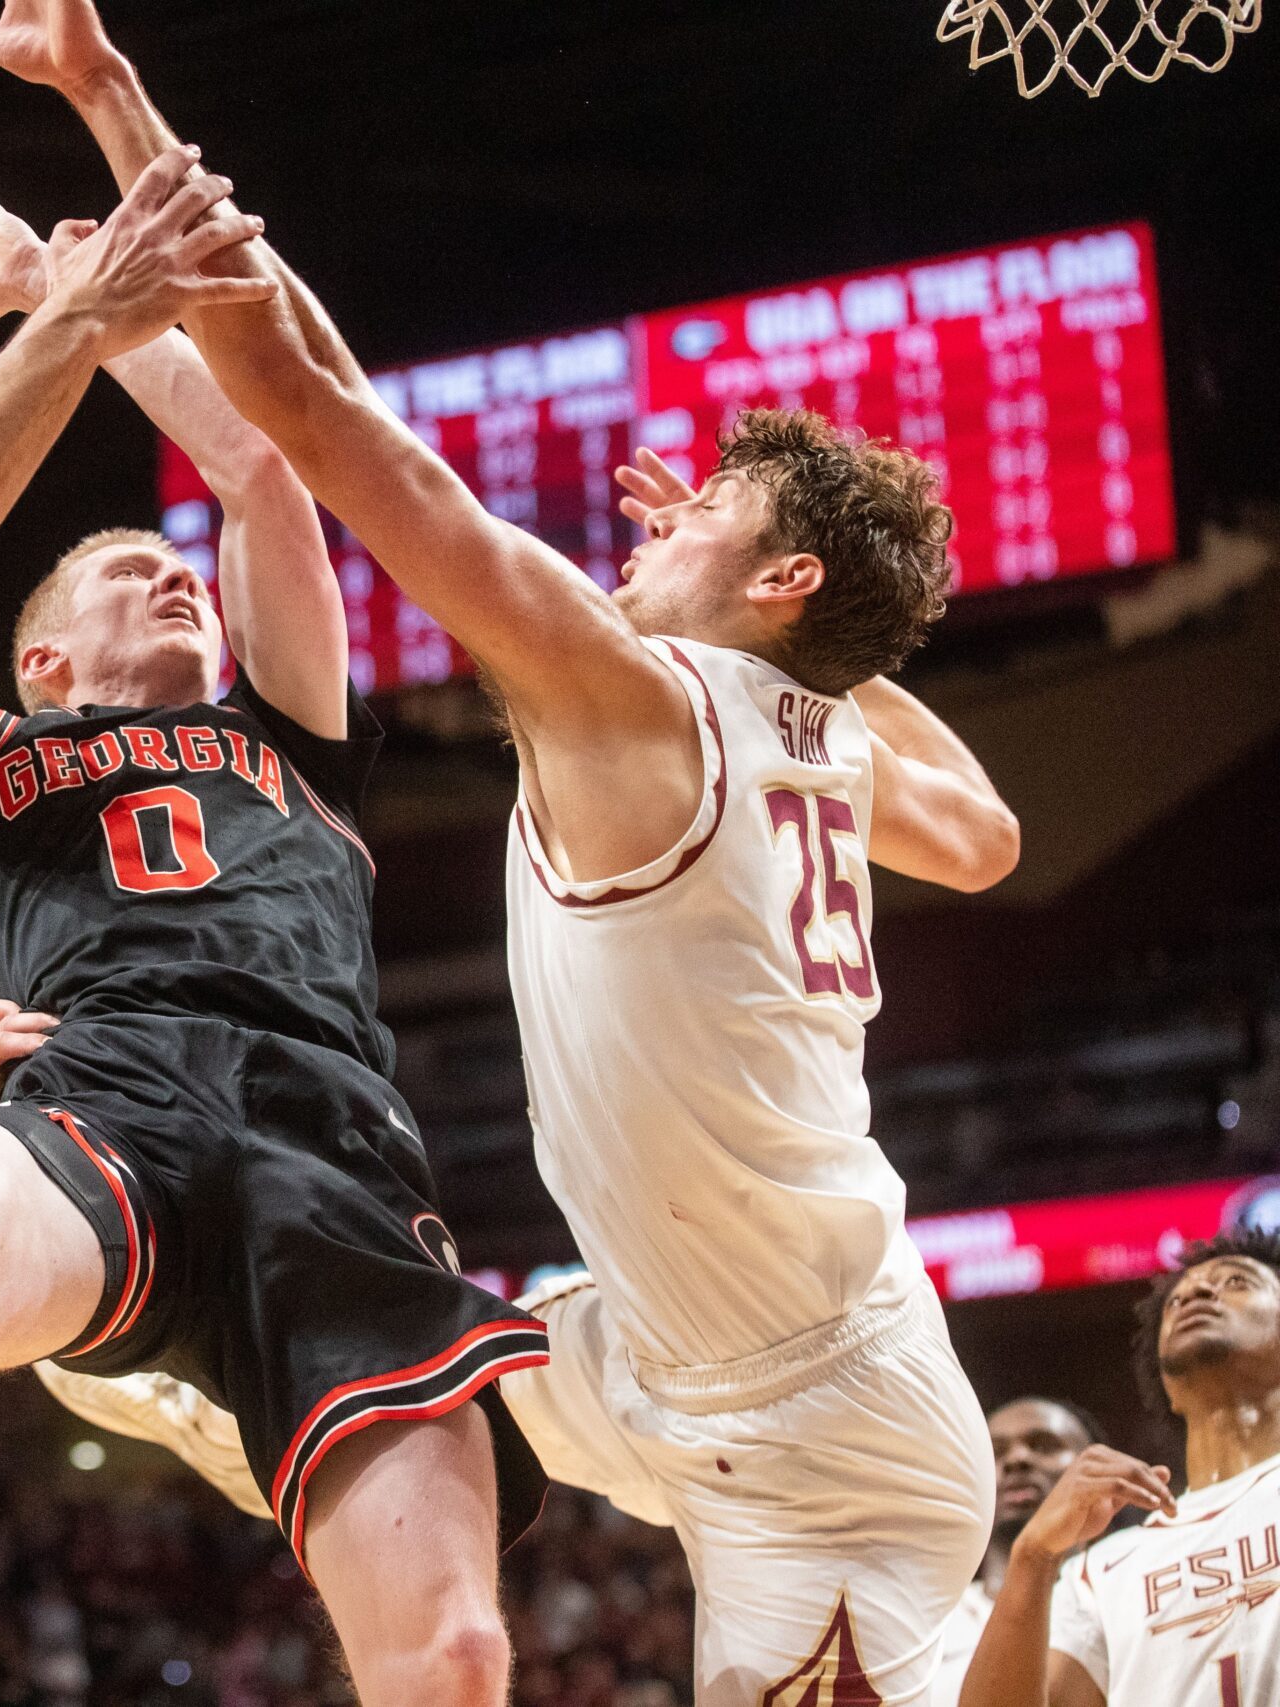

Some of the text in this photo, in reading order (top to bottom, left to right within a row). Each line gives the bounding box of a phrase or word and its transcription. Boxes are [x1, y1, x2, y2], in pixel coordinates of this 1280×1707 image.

[909, 257, 992, 321] THE
[998, 230, 1139, 304] FLOOR
[411, 355, 486, 416] THE
[492, 329, 628, 399] FLOOR
[99, 785, 221, 893] 0
[761, 785, 877, 1004] 25
[1143, 1524, 1280, 1616] FSU
